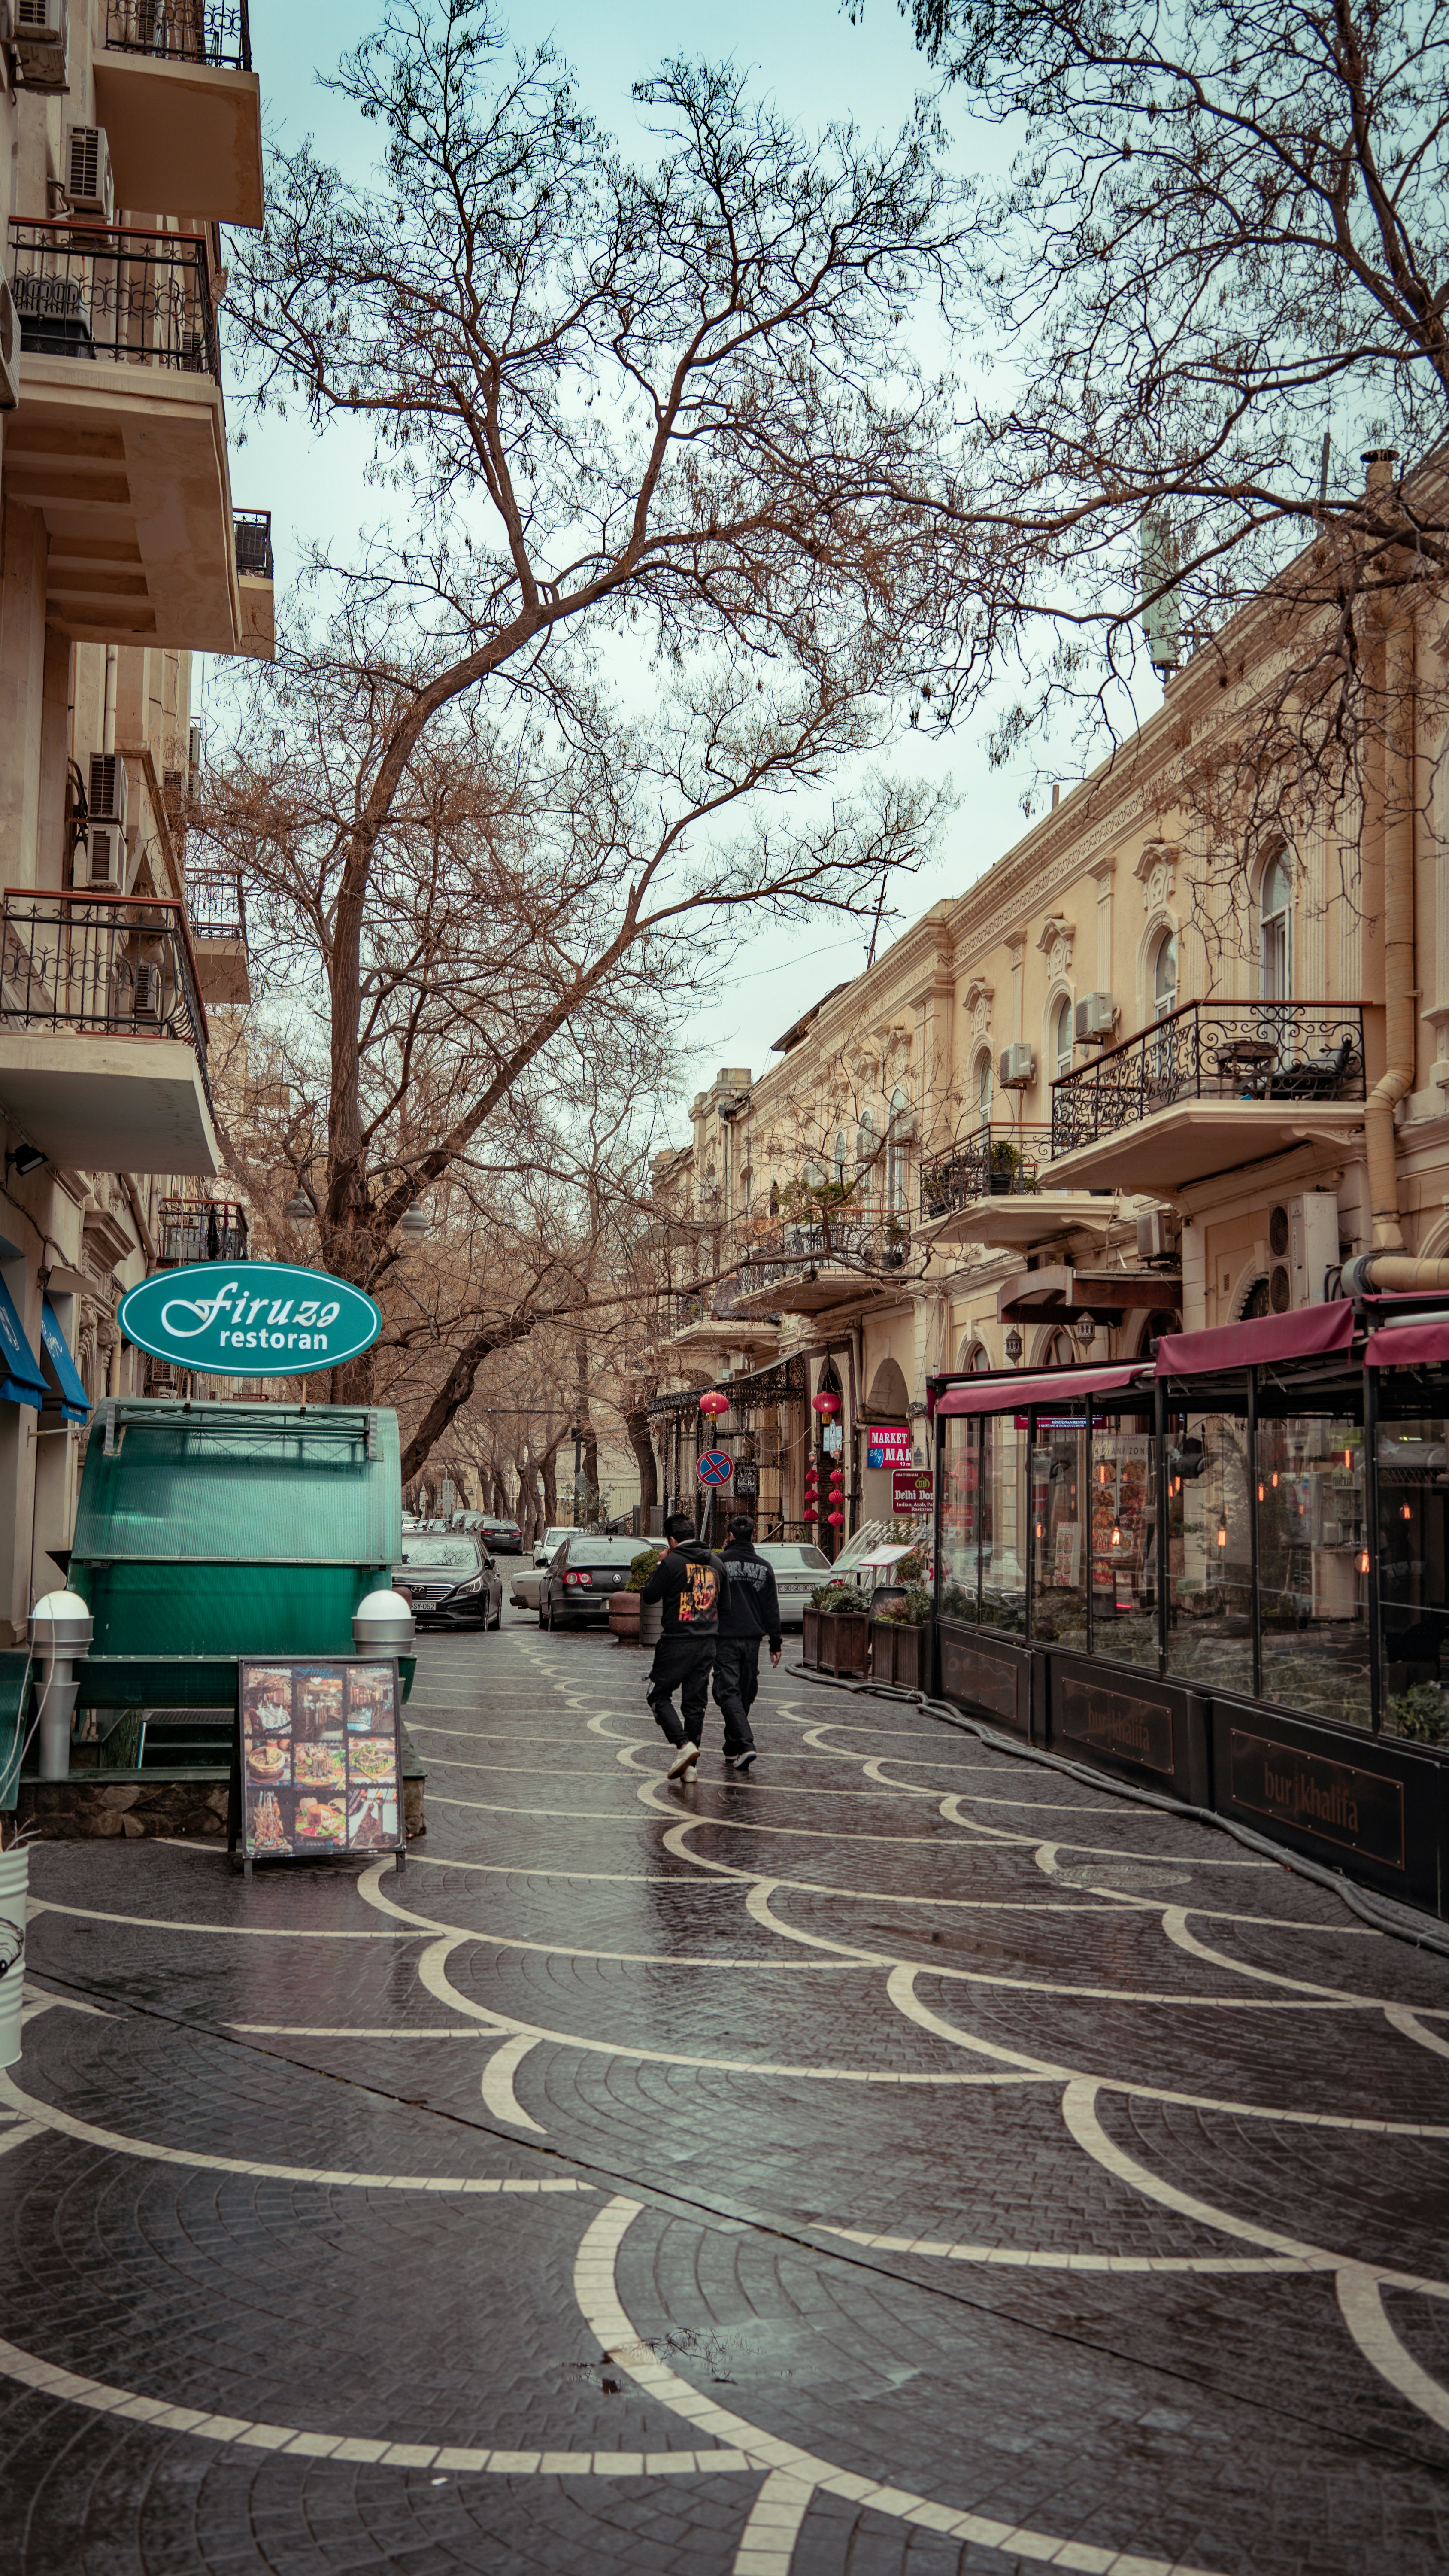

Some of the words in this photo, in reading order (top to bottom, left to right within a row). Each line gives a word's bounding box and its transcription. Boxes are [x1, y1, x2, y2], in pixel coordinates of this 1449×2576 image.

[220, 1328, 328, 1350] restoran
[871, 1432, 907, 1444] MARKET
[870, 1449, 882, 1463] 24/7
[885, 1448, 913, 1461] MAR
[894, 1490, 916, 1500] Delhi
